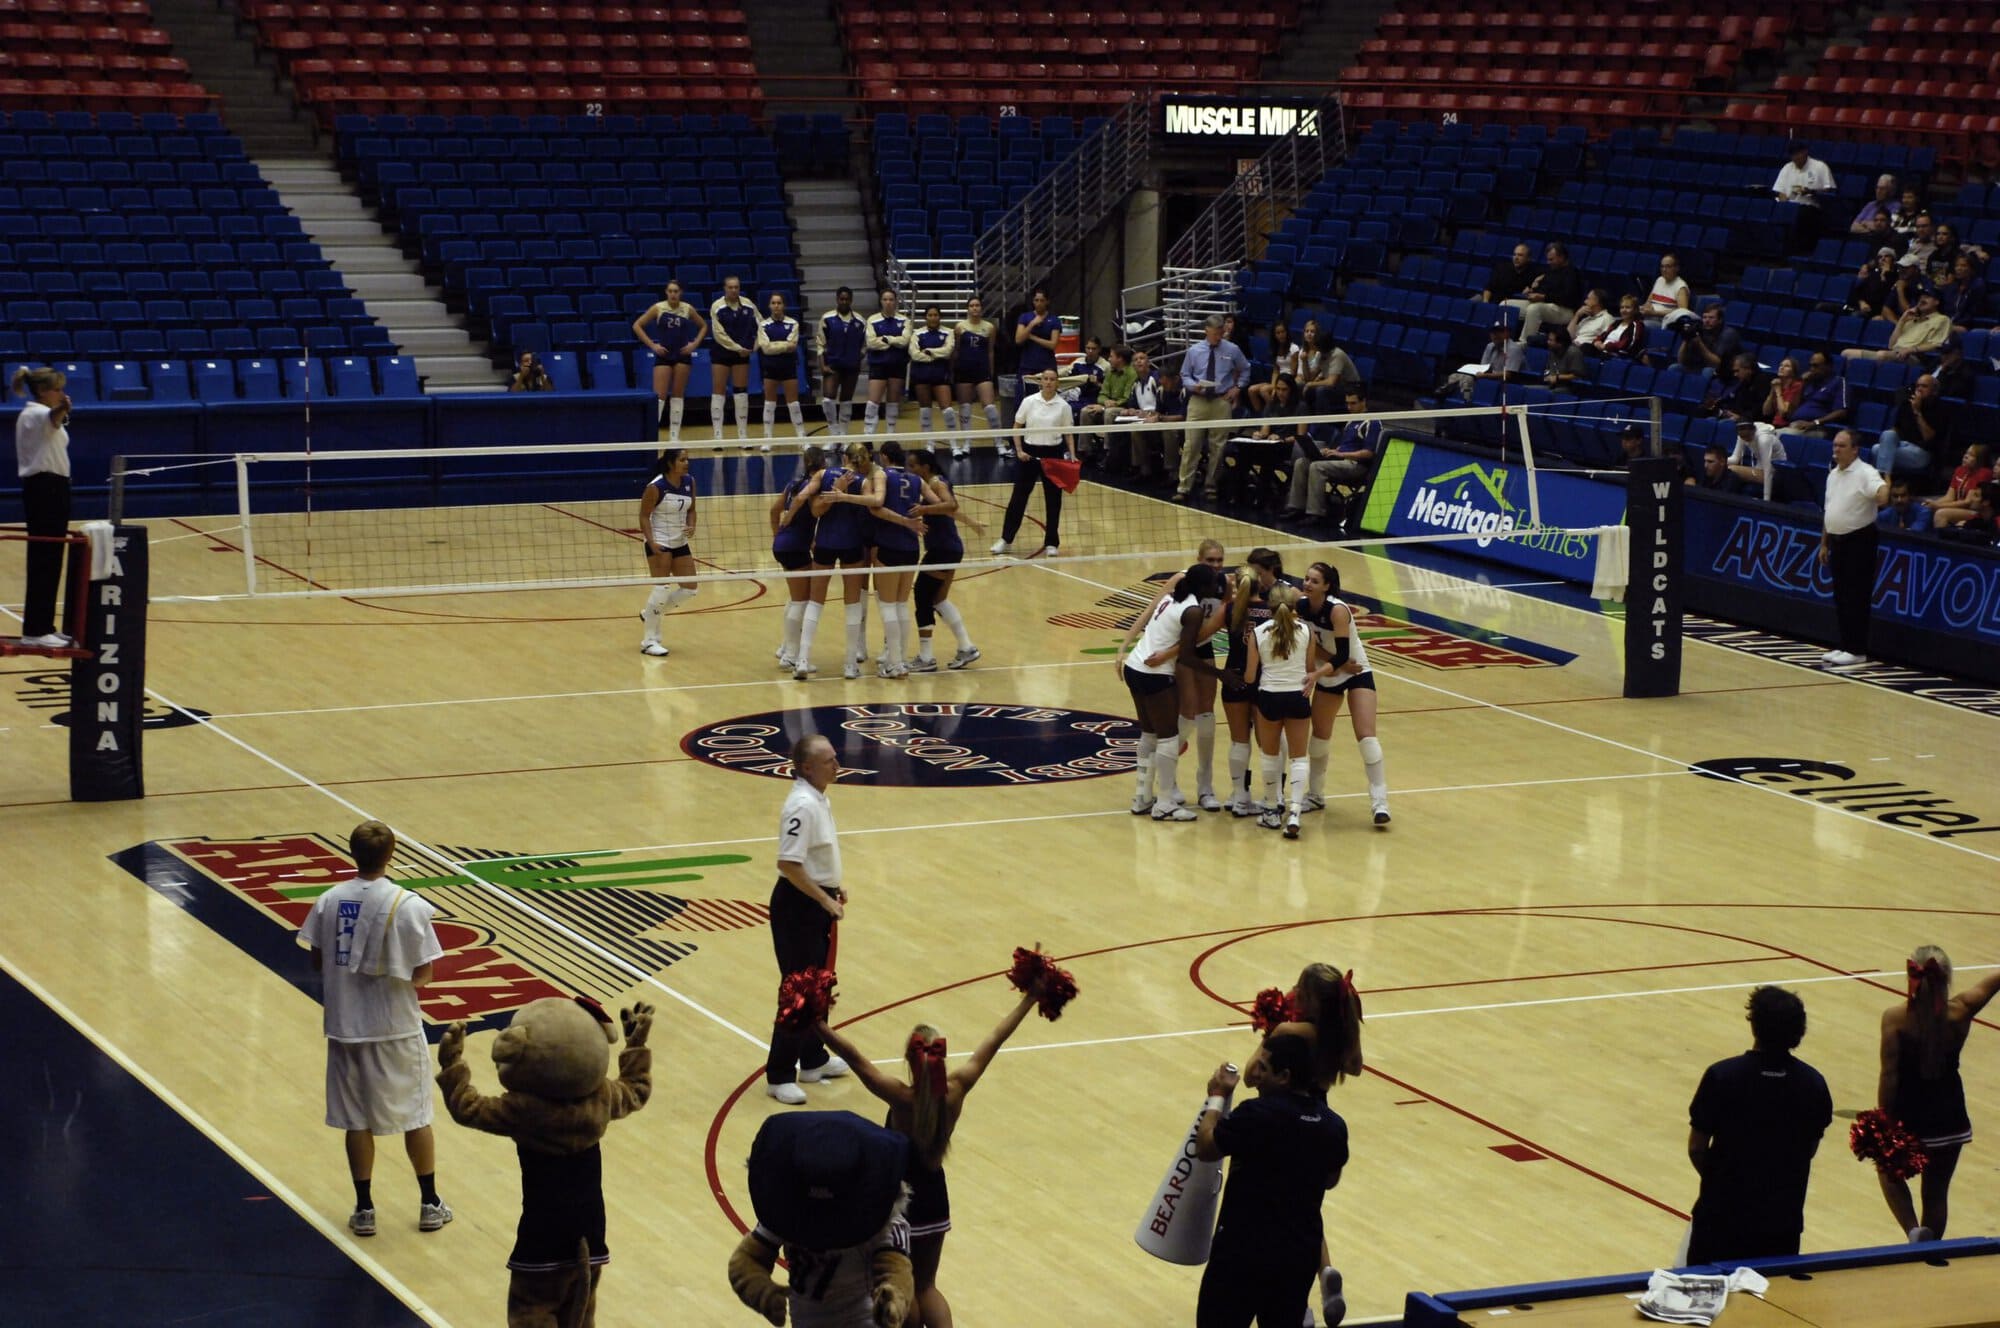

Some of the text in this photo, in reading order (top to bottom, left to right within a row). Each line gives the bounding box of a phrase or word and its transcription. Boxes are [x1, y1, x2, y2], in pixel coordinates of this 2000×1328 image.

[586, 103, 602, 116] 22
[1000, 105, 1016, 117] 23
[1442, 112, 1458, 126] 24
[1166, 105, 1318, 136] MUSCLE MILK
[667, 317, 681, 329] 24
[969, 336, 981, 347] 12
[899, 479, 910, 499] 2
[678, 499, 685, 512] 7
[1408, 486, 1514, 548] Meritage
[1651, 481, 1670, 660] WILDCATS
[96, 555, 124, 751] ARIZONA
[835, 704, 1071, 722] LUTE
[840, 719, 1010, 772] OLSON
[787, 817, 801, 837] 2
